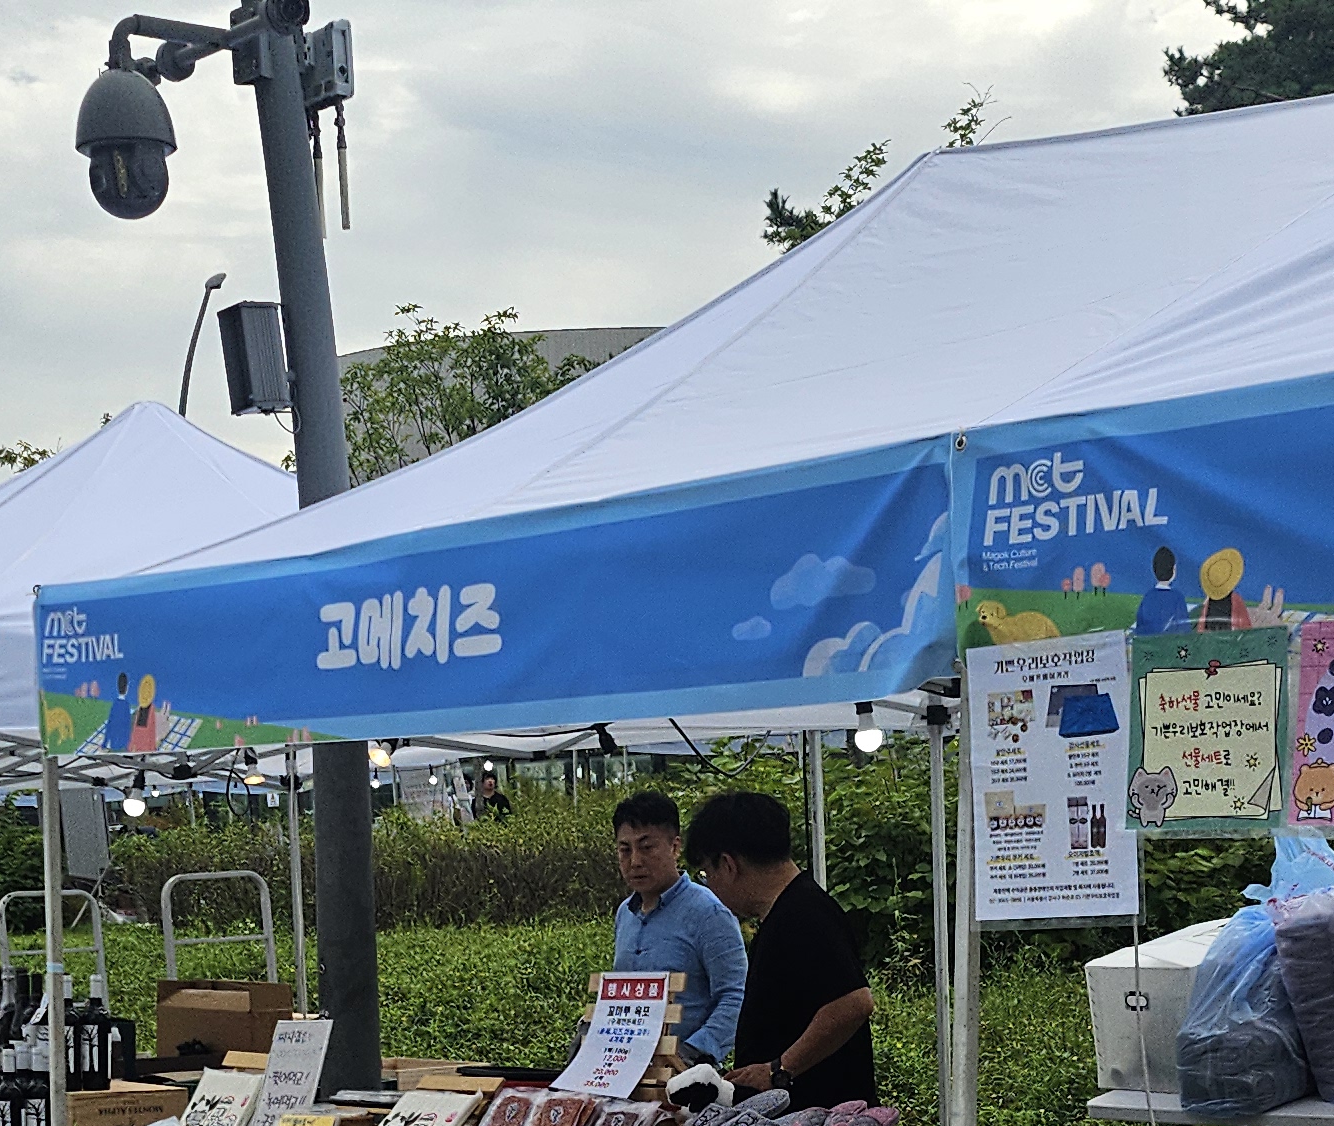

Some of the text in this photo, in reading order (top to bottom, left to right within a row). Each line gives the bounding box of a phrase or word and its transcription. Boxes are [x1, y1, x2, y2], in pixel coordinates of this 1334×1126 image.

[983, 487, 1169, 547] FESTIVAL
[317, 582, 503, 671] 고메치즈
[42, 633, 124, 665] FESTIVAL
[994, 649, 1095, 674] 기쁜우리보호작업장
[1158, 690, 1262, 712] 축하선물 고민이세요?
[1151, 719, 1270, 739] 기쁜우리보호작업장에서
[1181, 747, 1232, 768] 선물세트로
[1182, 778, 1235, 797] 고민해결!!
[607, 982, 659, 997] 행사상품
